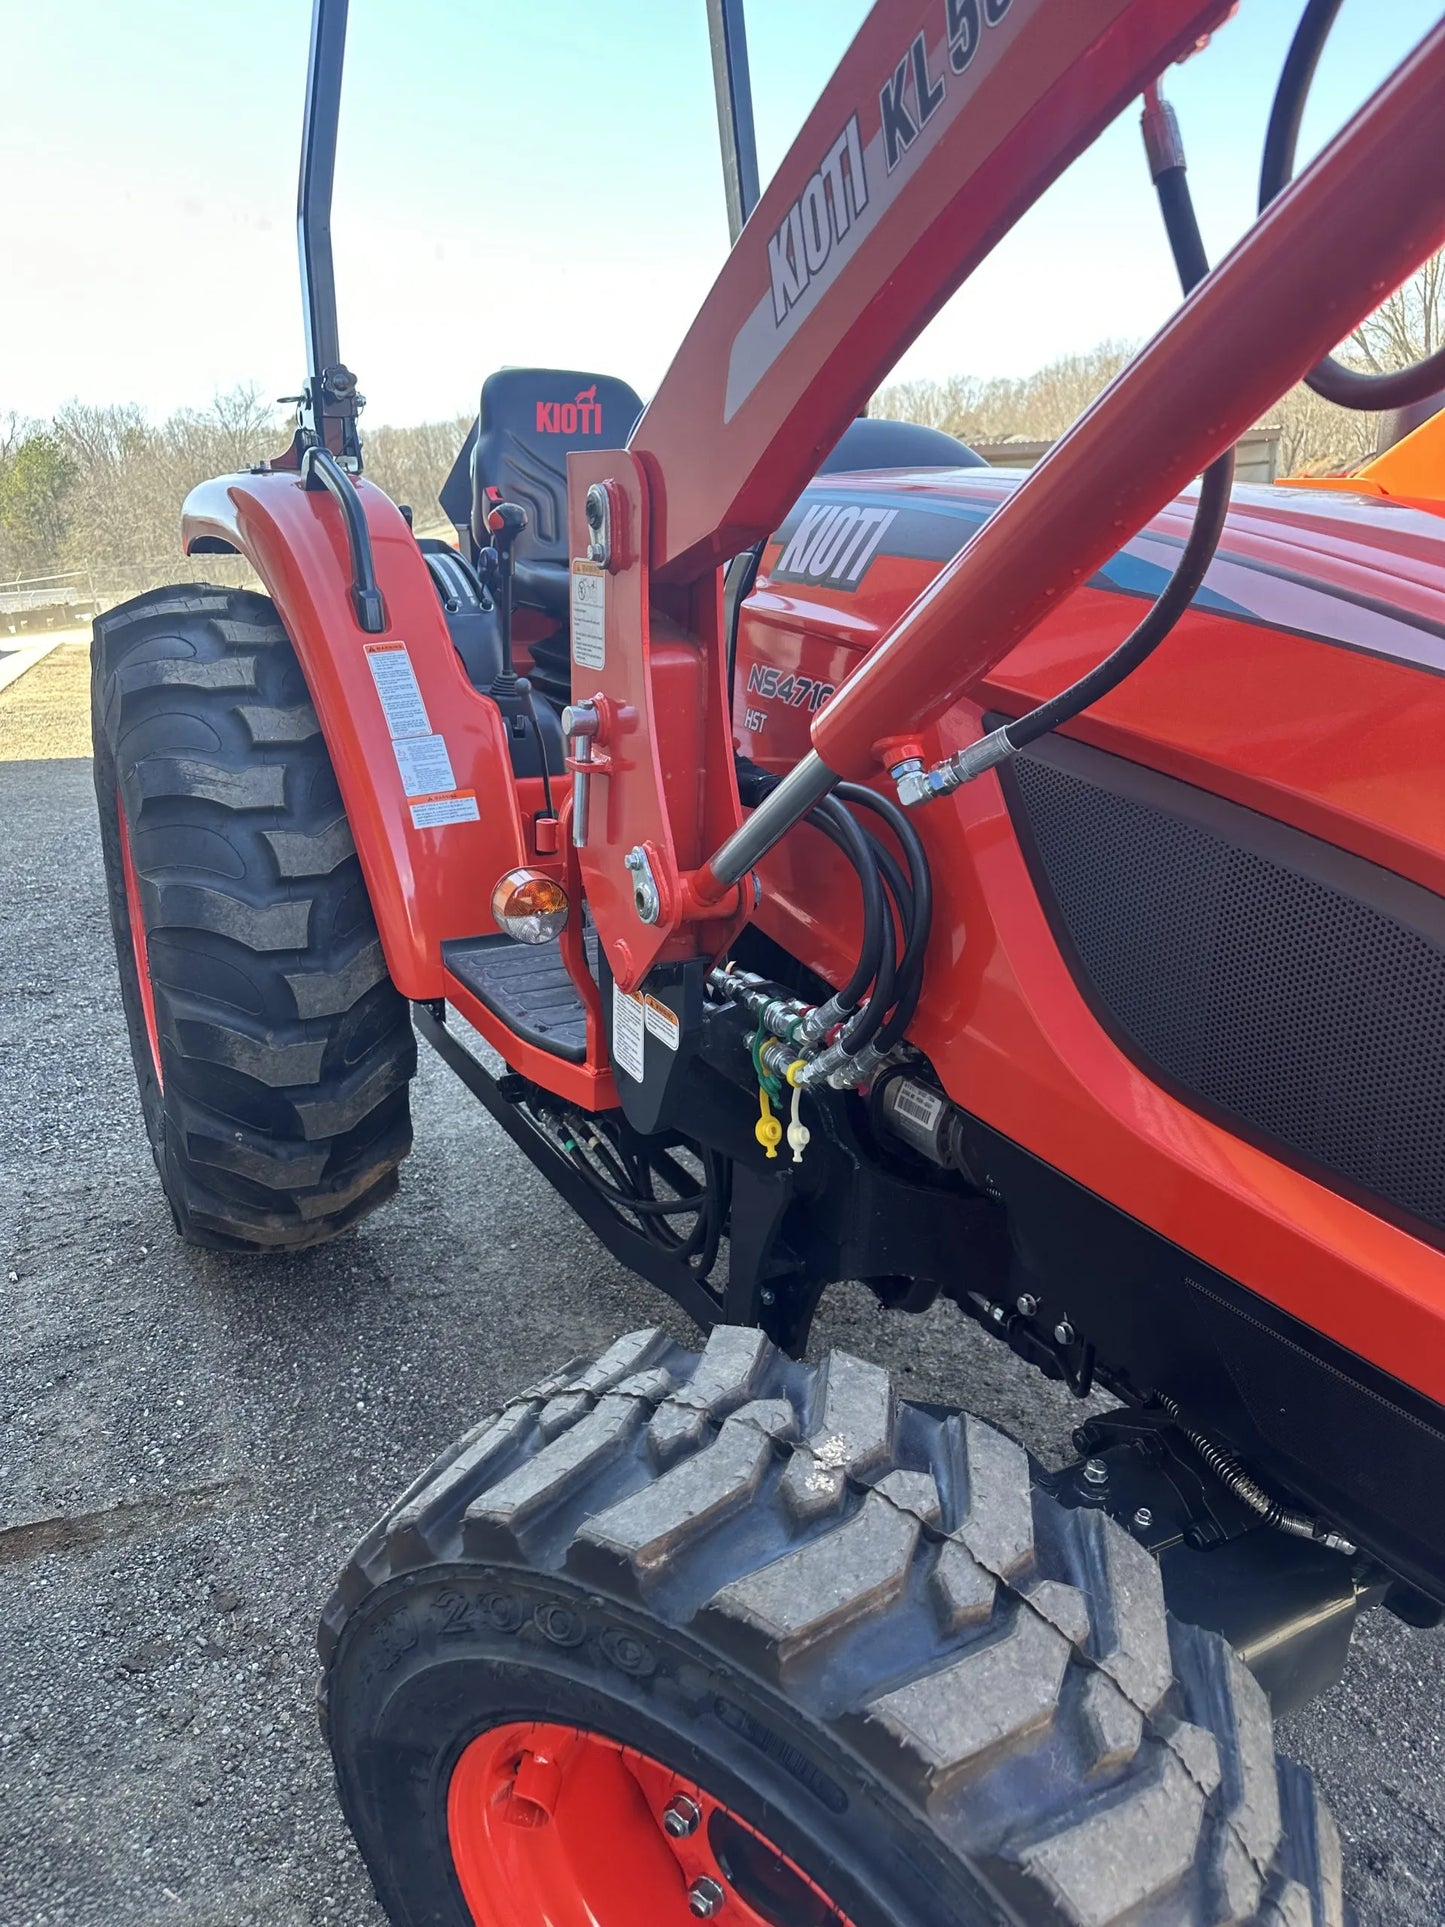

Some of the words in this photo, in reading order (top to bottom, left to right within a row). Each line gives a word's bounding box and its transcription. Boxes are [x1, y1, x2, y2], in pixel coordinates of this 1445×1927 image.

[767, 109, 869, 328] KIOTI
[879, 28, 946, 175] KL
[536, 402, 602, 434] KIOTI
[777, 504, 899, 581] KIOTI
[744, 708, 768, 733] HST
